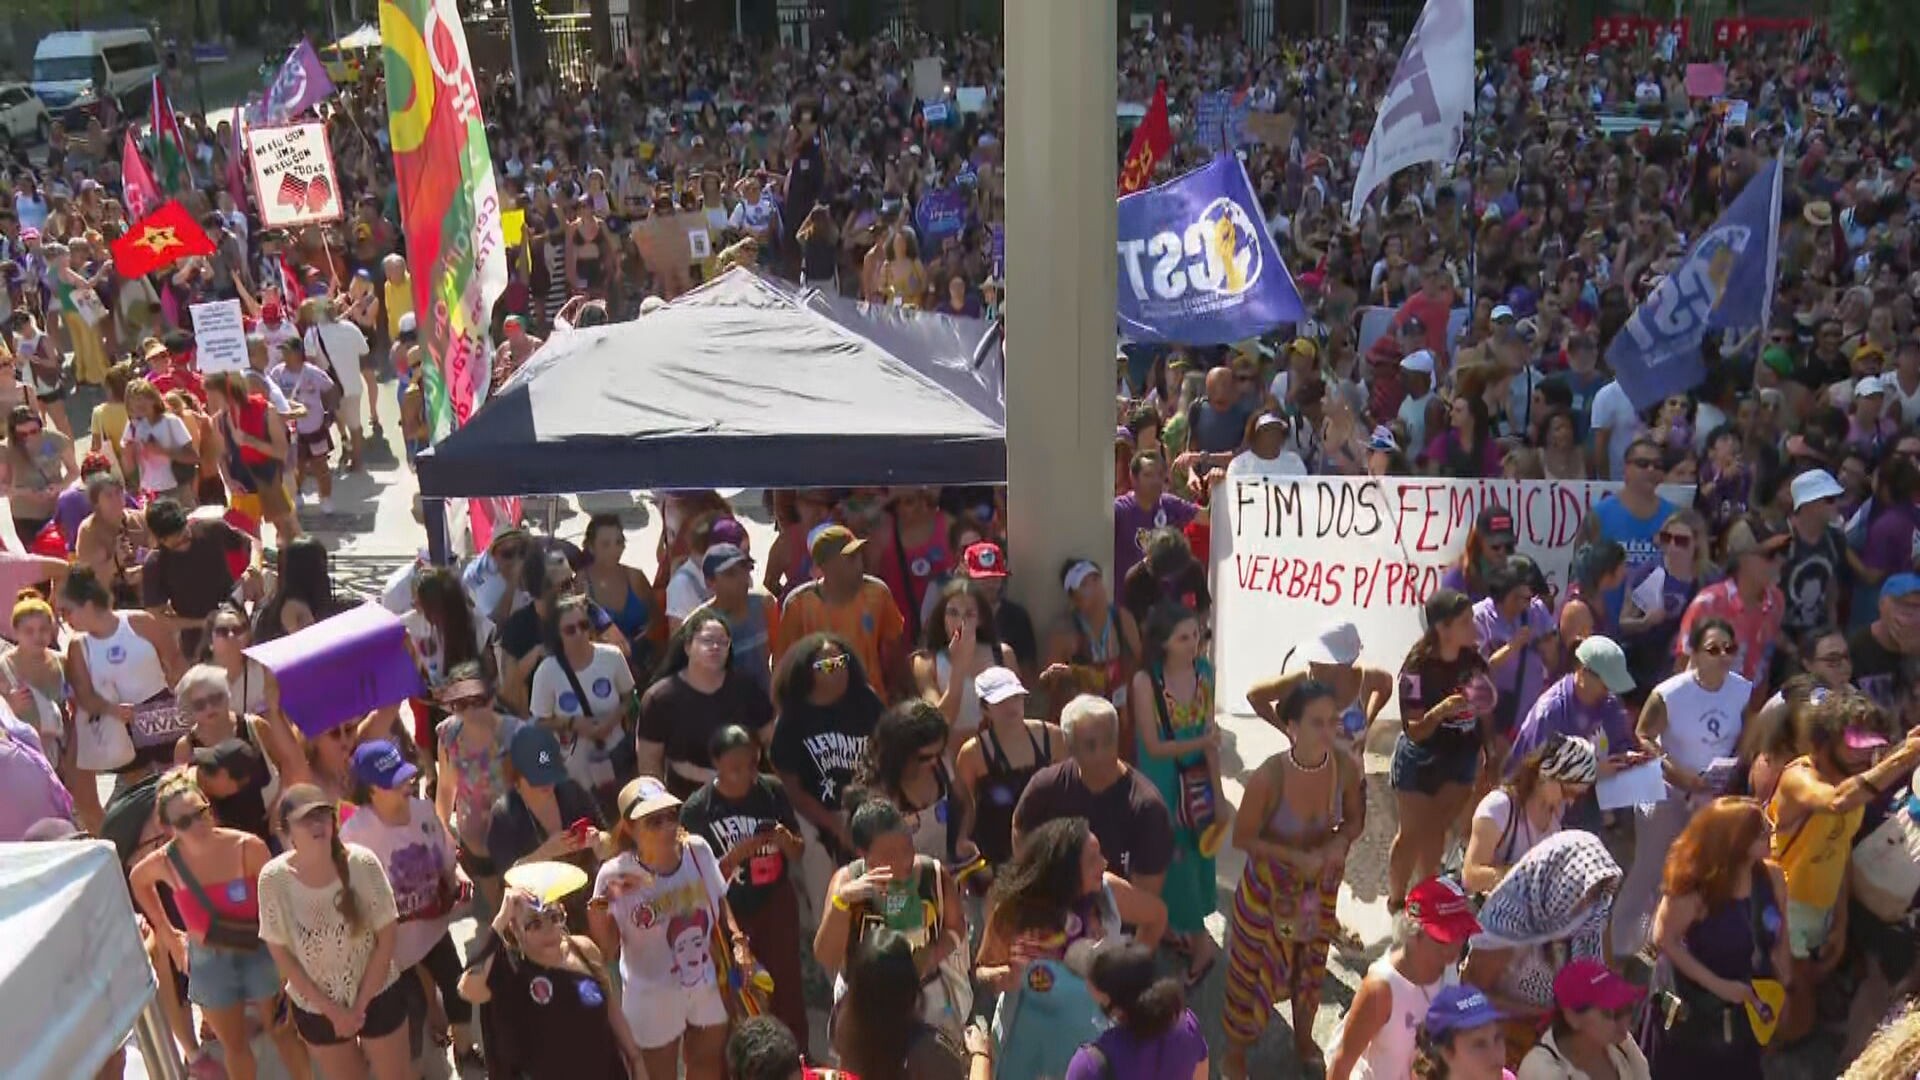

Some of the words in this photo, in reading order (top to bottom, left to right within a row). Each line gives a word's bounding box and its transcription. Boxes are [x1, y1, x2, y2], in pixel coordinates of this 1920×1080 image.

[285, 128, 305, 142] COM
[275, 146, 295, 159] UMA
[291, 148, 311, 164] COM
[294, 163, 325, 175] TODAS
[1236, 476, 1303, 537] FIM
[1316, 480, 1382, 537] DOS
[1236, 554, 1345, 606] VERBAS
